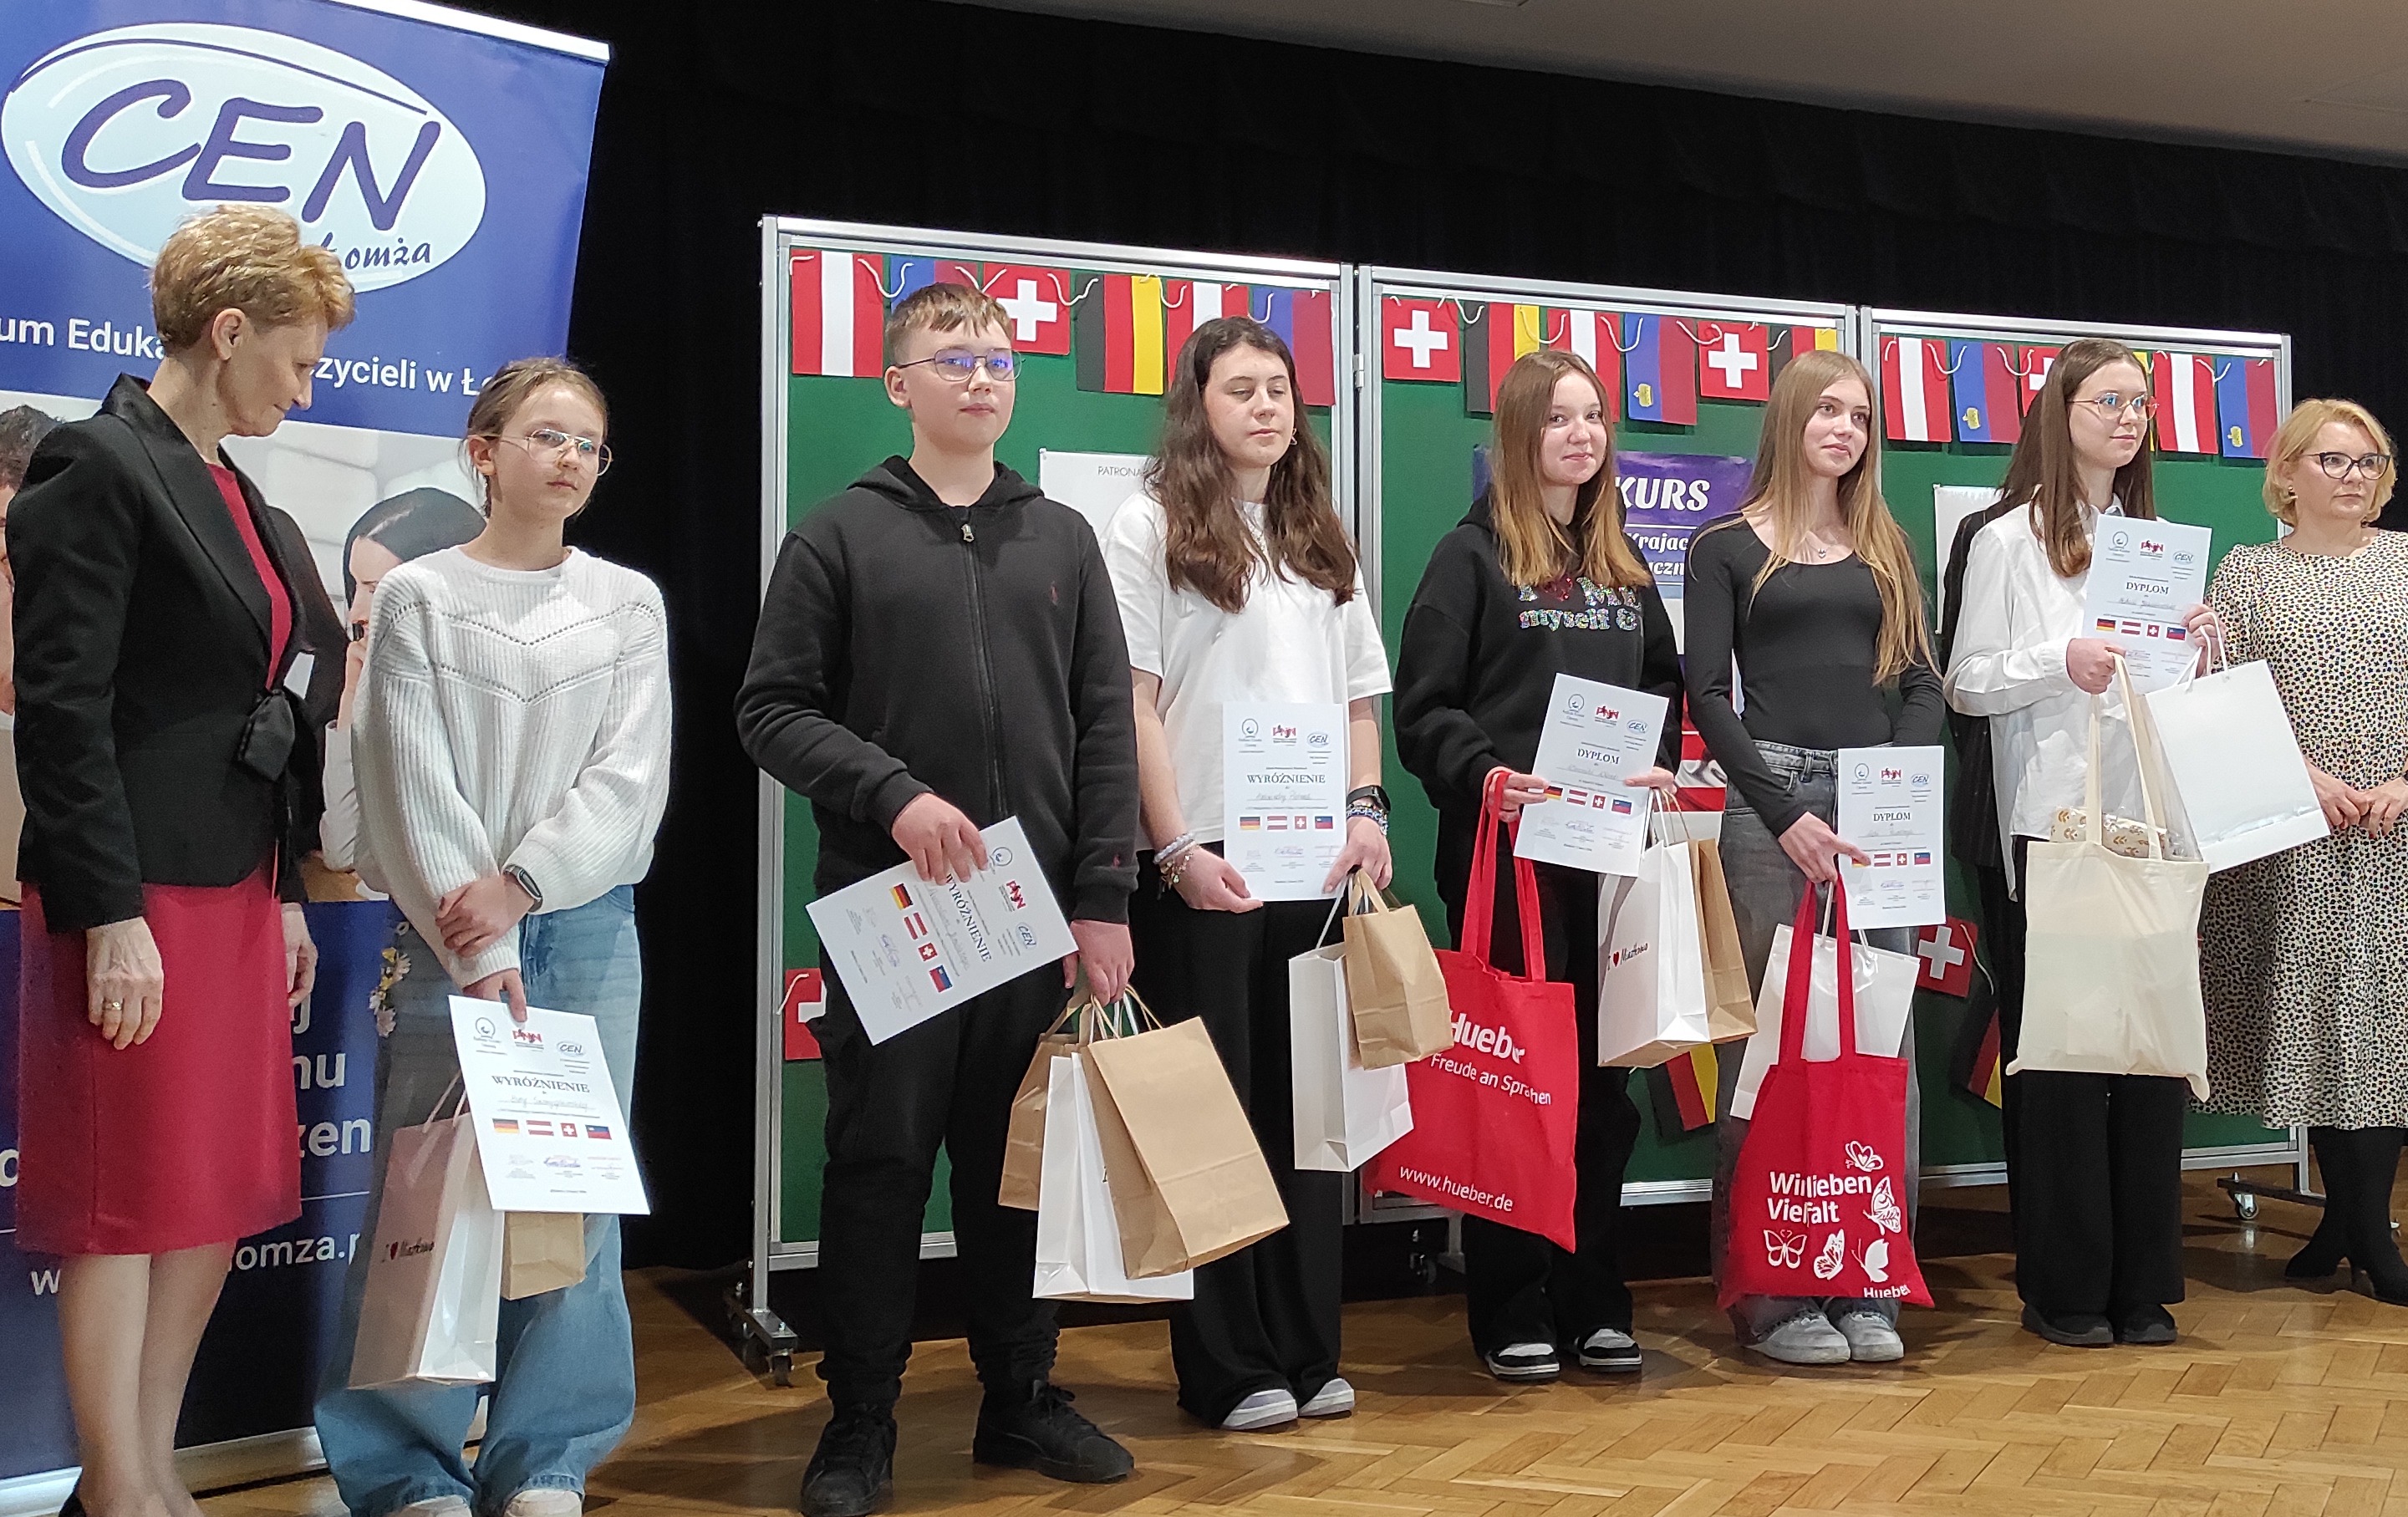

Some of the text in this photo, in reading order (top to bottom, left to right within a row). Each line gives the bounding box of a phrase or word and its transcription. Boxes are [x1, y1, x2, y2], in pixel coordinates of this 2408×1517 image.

[61, 79, 441, 232] CEN
[309, 355, 417, 389] zycieli
[425, 369, 454, 393] w
[2175, 552, 2194, 562] CEN
[2126, 582, 2169, 594] DYPLOM
[1628, 722, 1647, 731] CEN
[1310, 734, 1328, 743] CEN
[1577, 748, 1620, 764] DYPLOM
[1246, 772, 1326, 783] WYRÓŻNIENIE
[1912, 775, 1929, 783] CEN
[1873, 812, 1911, 822] DYPLOM
[945, 873, 992, 962] WYRÓŻNIENIE
[1018, 926, 1036, 947] CEN
[559, 1043, 583, 1054] CEN
[1430, 1052, 1477, 1081] Freude
[1479, 1071, 1499, 1089] an
[491, 1075, 591, 1093] WYRÓŻNIENIE
[1399, 1165, 1514, 1212] www.hueber.de
